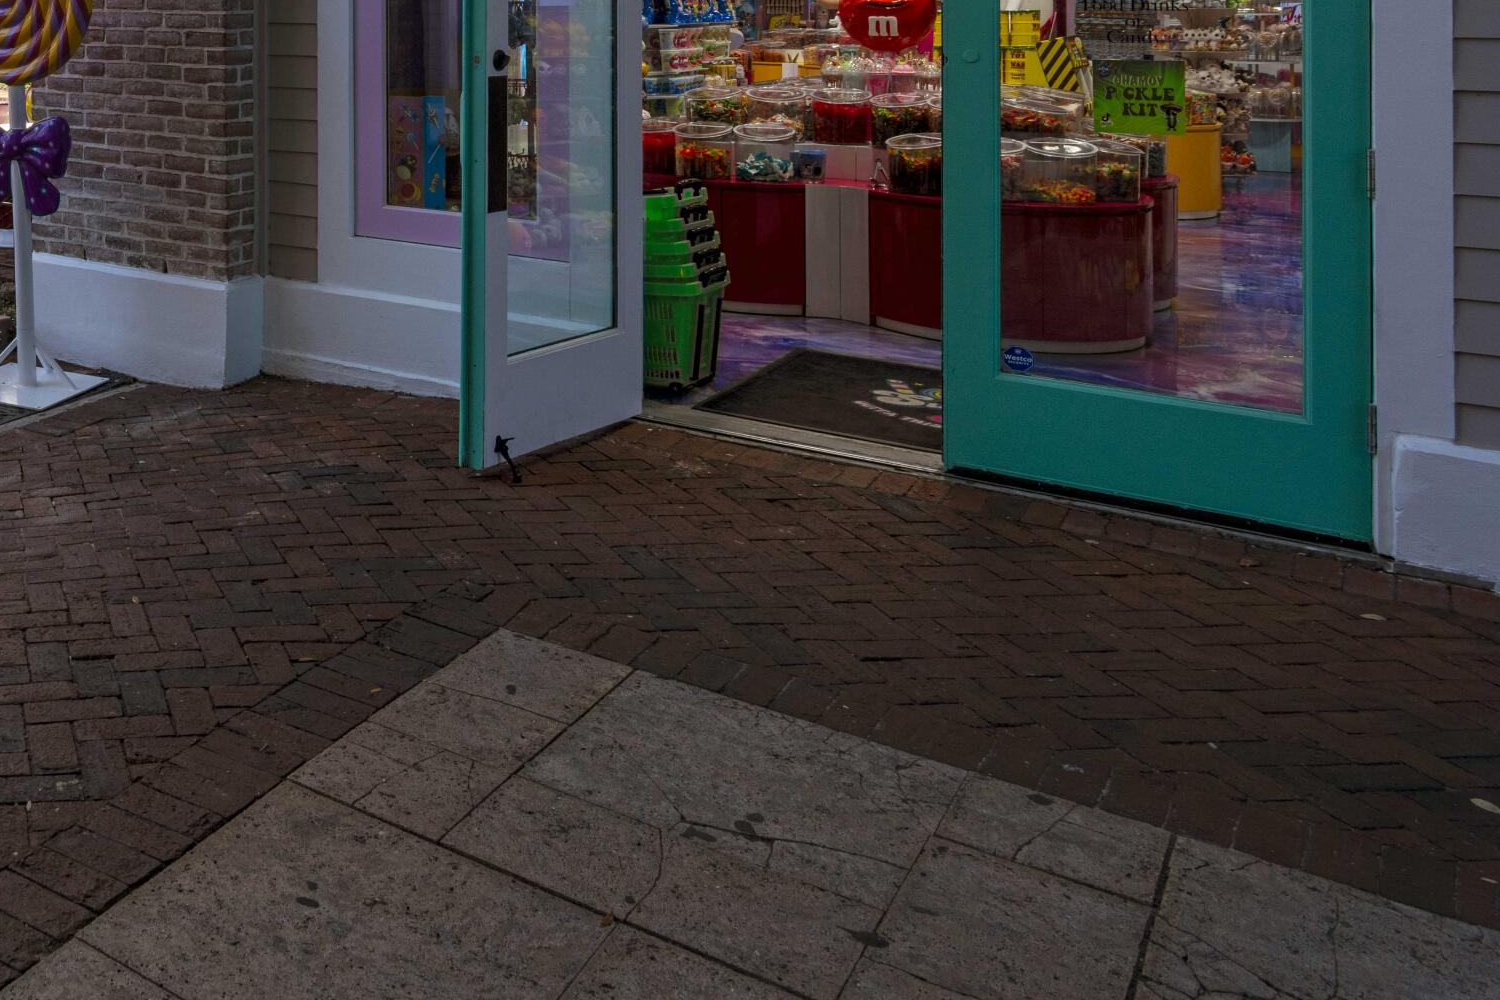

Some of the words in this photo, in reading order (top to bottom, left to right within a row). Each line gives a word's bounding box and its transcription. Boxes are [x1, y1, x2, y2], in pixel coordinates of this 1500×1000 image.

[868, 15, 899, 37] m
[1124, 16, 1143, 27] or
[1106, 29, 1164, 47] Candy
[1122, 102, 1158, 118] KIT
